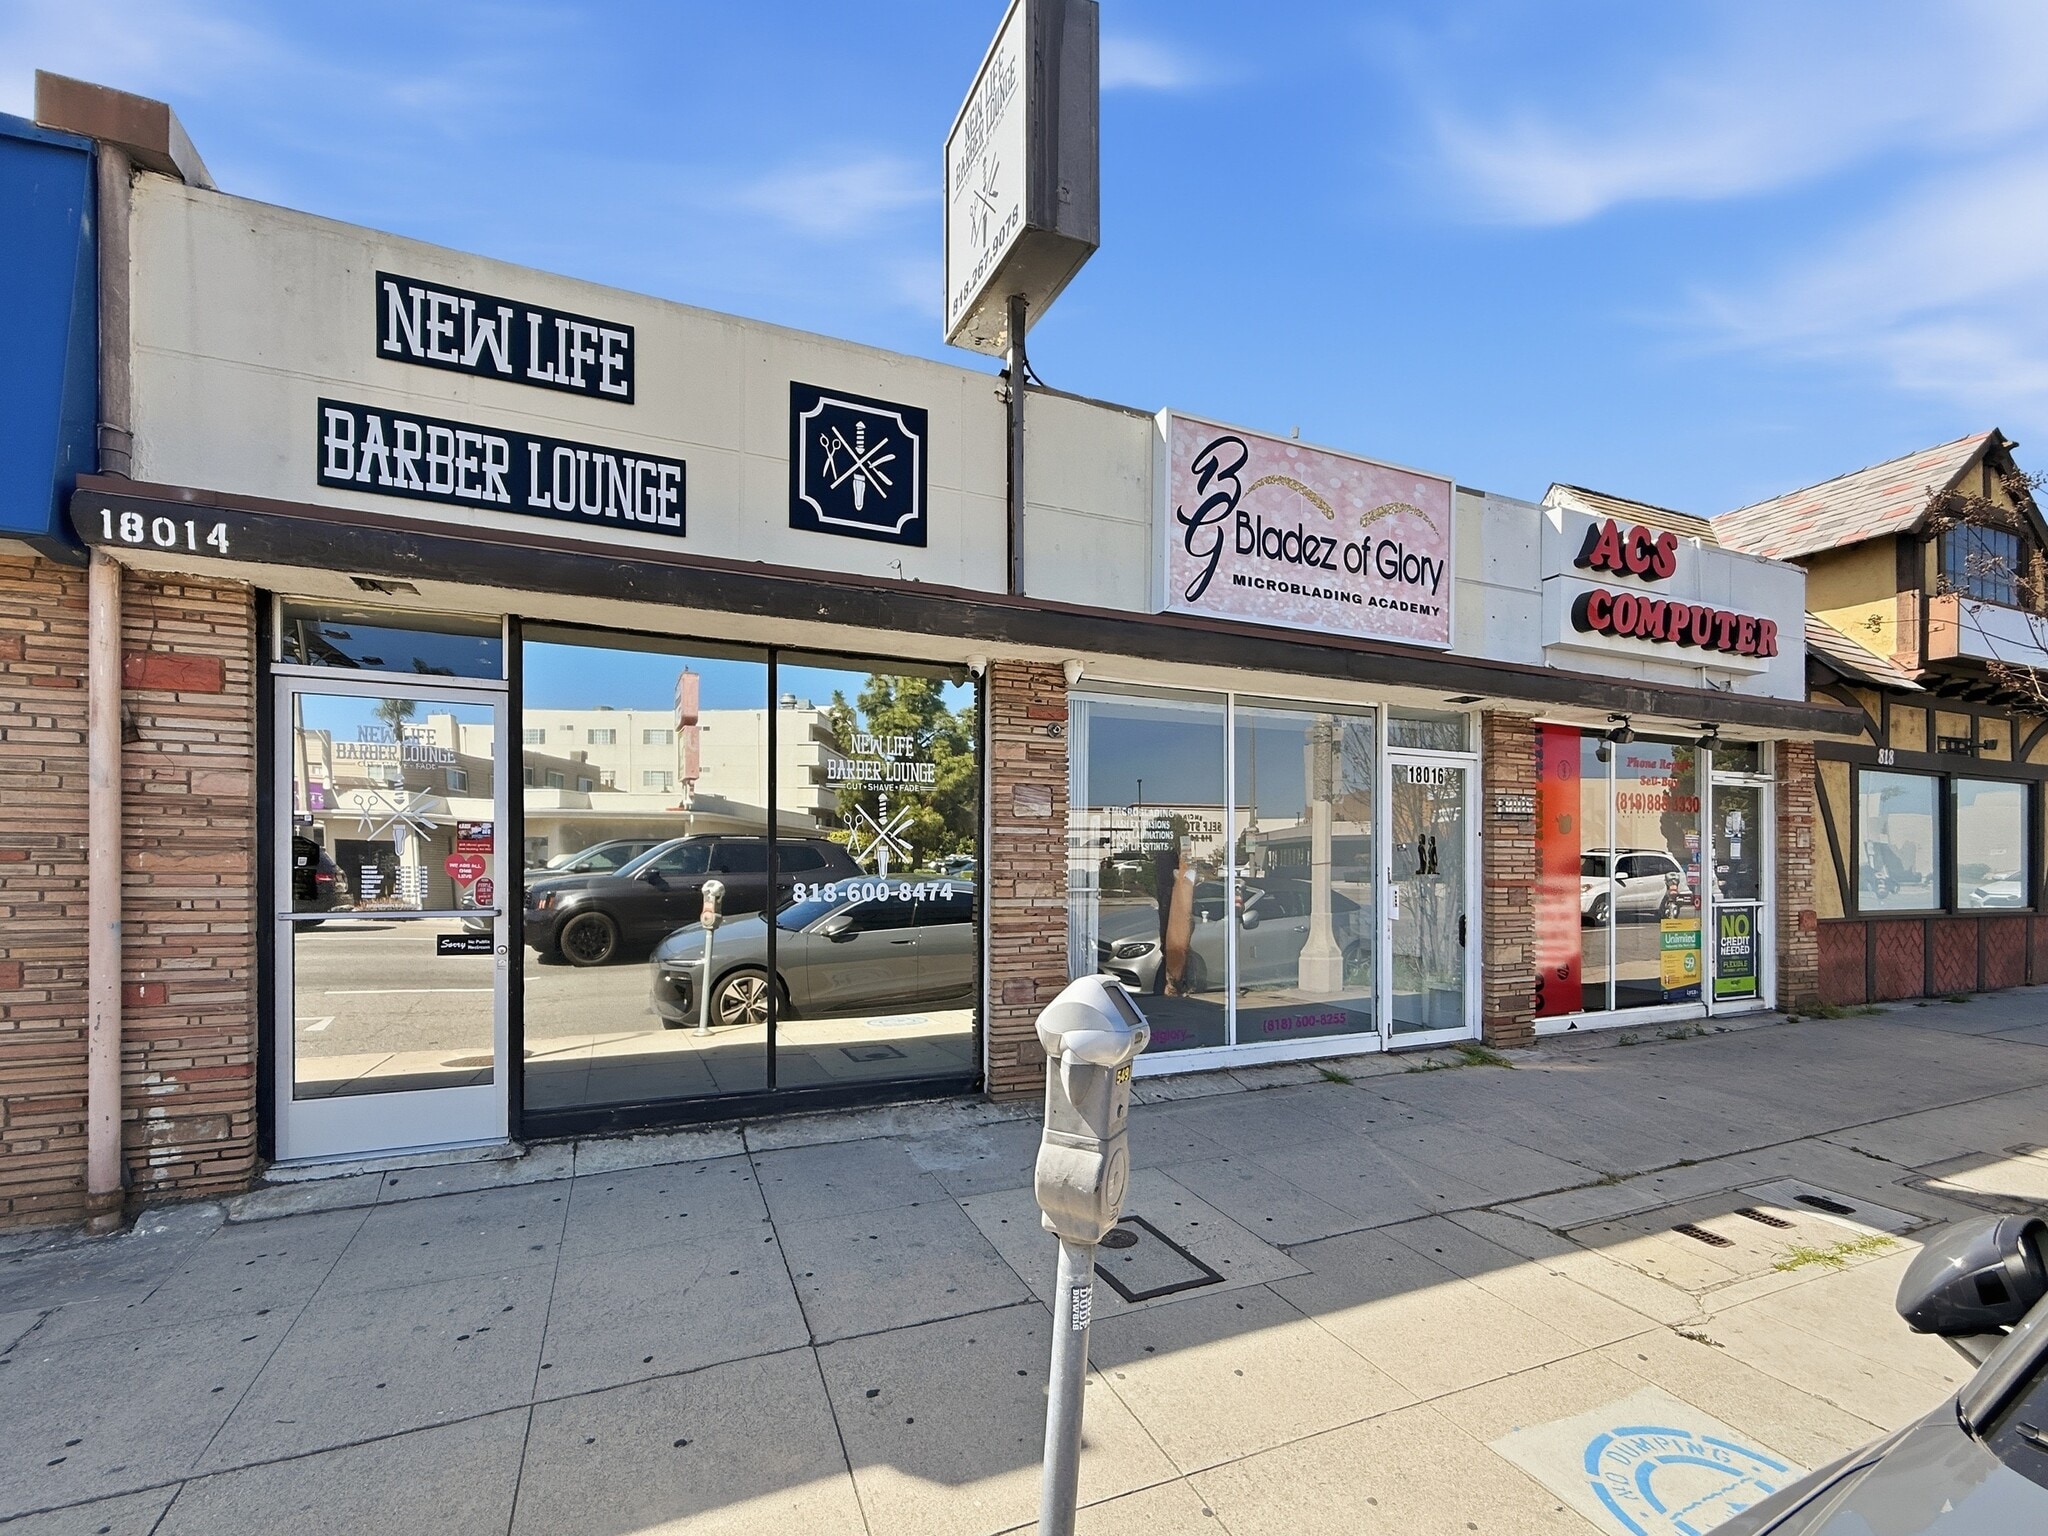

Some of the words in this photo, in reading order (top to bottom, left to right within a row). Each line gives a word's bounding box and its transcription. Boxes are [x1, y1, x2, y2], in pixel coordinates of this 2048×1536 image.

[965, 90, 983, 148] NEW
[985, 46, 1004, 108] LIFE
[956, 118, 984, 191] BARBER
[986, 54, 1016, 134] LOUNGE
[953, 203, 1018, 316] 818.267.9078
[383, 281, 512, 374] NEW
[526, 312, 628, 396] LIFE
[323, 407, 511, 504] BARBER
[528, 442, 682, 527] LOUNGE
[101, 508, 230, 554] 18014
[1235, 510, 1337, 571] Bladez
[1343, 536, 1371, 575] of
[1376, 540, 1444, 596] Glory
[1577, 519, 1678, 581] ACS
[1232, 574, 1362, 605] MICROBLADING
[1368, 596, 1440, 616] ACADEMY
[1574, 589, 1778, 657] COMPUTER
[357, 725, 396, 743] NEW
[402, 728, 436, 746] LIFE
[850, 734, 884, 755] NEW
[886, 736, 914, 758] LIFE
[336, 743, 400, 760] BARBER
[402, 745, 456, 763] LOUNGE
[1626, 757, 1657, 769] Phone
[1878, 748, 1894, 766] 818
[827, 759, 882, 782] BARBER
[886, 762, 935, 783] LOUNGE
[1408, 766, 1444, 785] 18016
[867, 783, 894, 792] SHAVE
[899, 785, 920, 793] FADE
[792, 882, 954, 903] 818-600-8474
[1665, 932, 1696, 944] Unlimited
[1721, 914, 1750, 938] NO
[440, 939, 466, 950] Sorry
[1721, 936, 1750, 947] CREDIT
[1721, 945, 1750, 956] NEEDED
[1263, 1017, 1293, 1034] (818)
[1606, 1437, 1731, 1466] DUMPING
